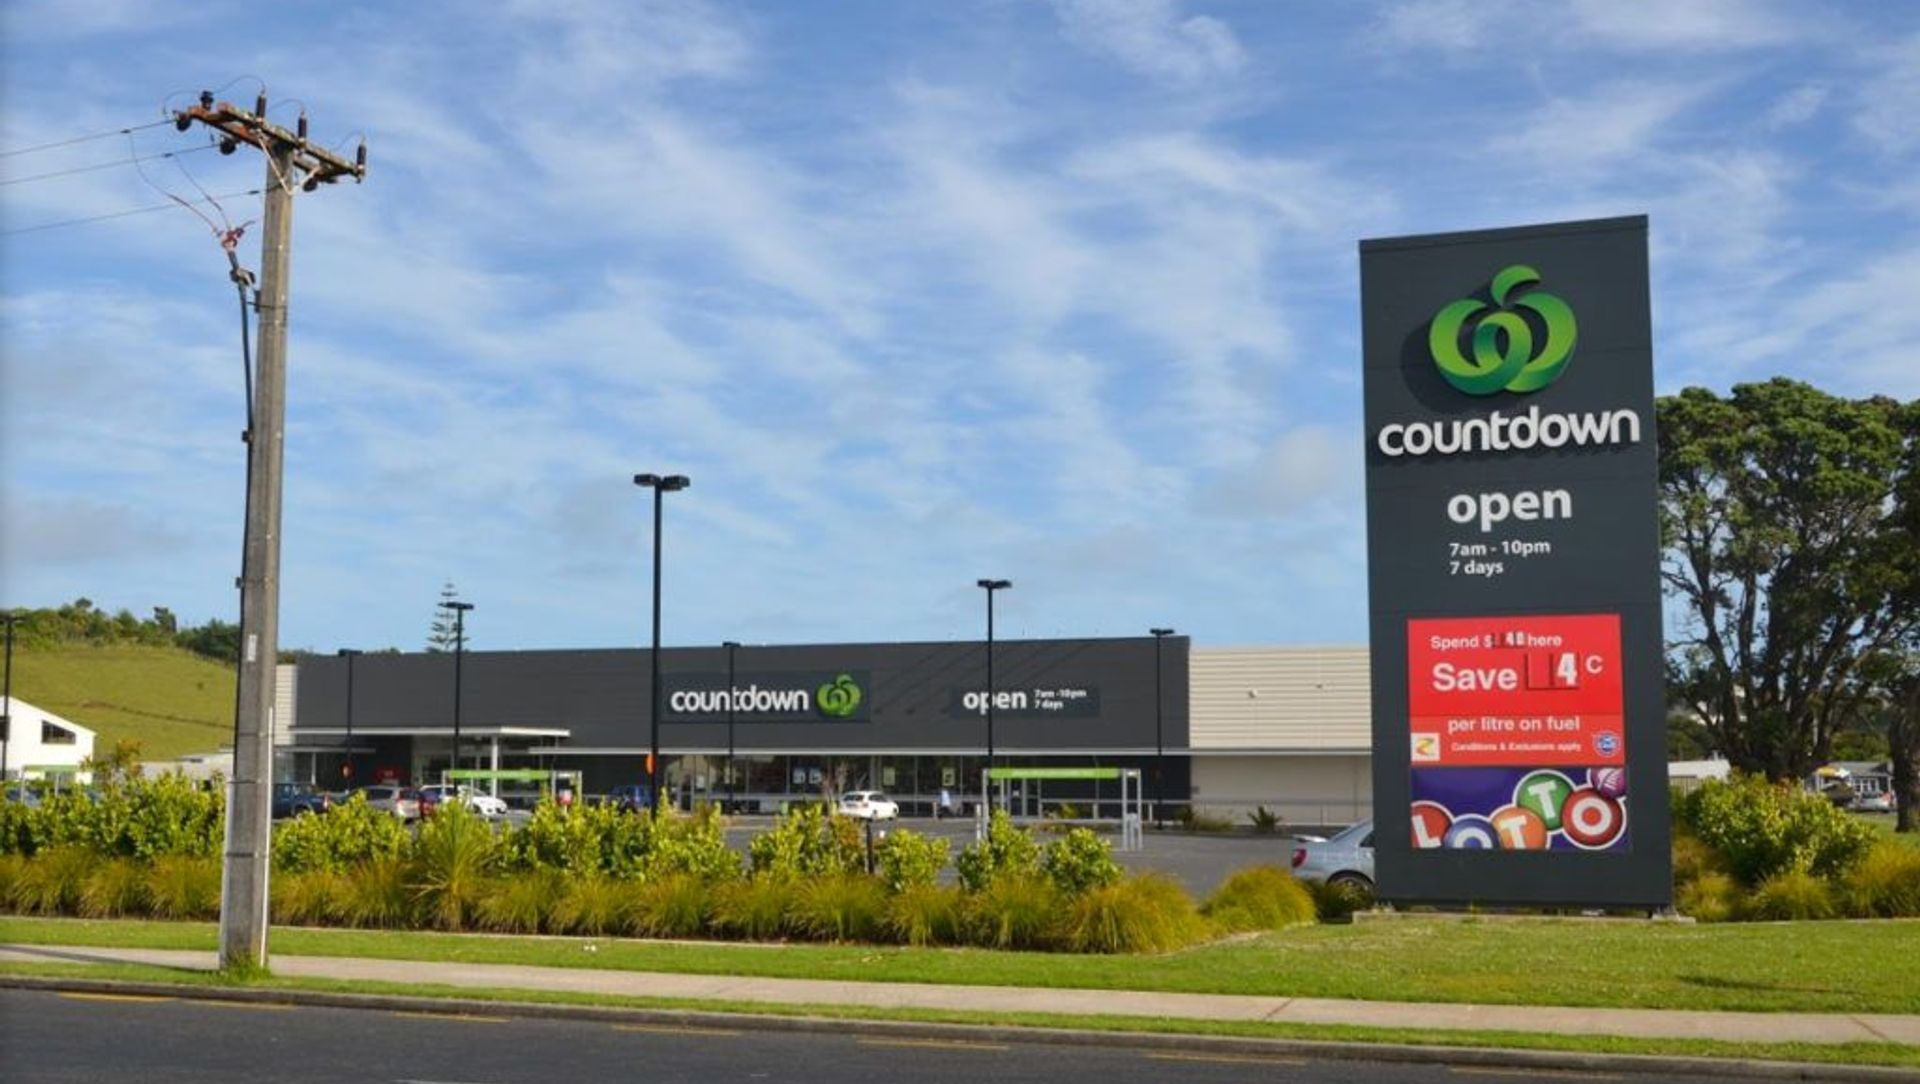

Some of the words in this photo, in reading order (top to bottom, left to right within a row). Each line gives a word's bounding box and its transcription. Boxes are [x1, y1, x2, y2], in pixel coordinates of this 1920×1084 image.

[1378, 405, 1640, 456] countdown
[1447, 489, 1573, 532] open
[1450, 543, 1487, 557] 7am
[1501, 540, 1551, 556] 10pm
[1450, 561, 1459, 574] 7
[1463, 559, 1504, 577] days
[1430, 635, 1479, 650] Spend
[1527, 633, 1562, 647] here
[1432, 662, 1518, 691] Save
[1557, 652, 1577, 686] 4
[670, 684, 809, 712] countdown
[962, 691, 1027, 715] open
[1448, 719, 1475, 734] per
[1481, 717, 1514, 731] litre
[1519, 718, 1541, 731] on
[1547, 715, 1580, 731] fuel
[1411, 780, 1612, 849] LOTTO
